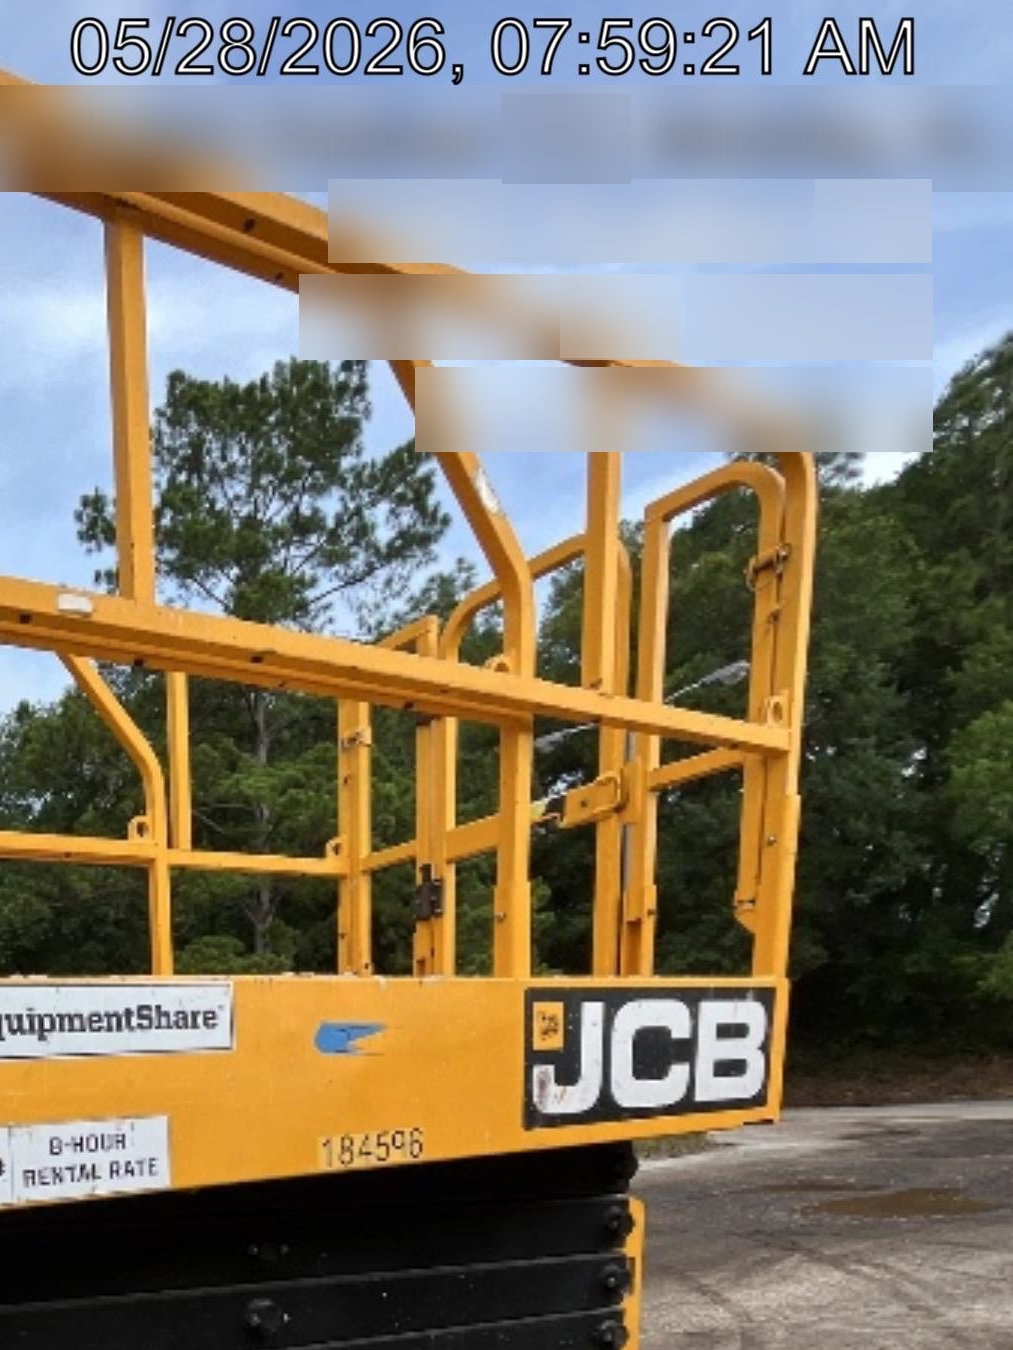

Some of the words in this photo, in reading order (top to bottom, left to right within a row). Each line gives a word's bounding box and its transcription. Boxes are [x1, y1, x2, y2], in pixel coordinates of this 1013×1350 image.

[532, 998, 770, 1115] JCB
[49, 1132, 126, 1156] 8-HOUR
[321, 1126, 424, 1169] 184596
[22, 1162, 102, 1188] RENTAL
[109, 1157, 158, 1179] RATE
